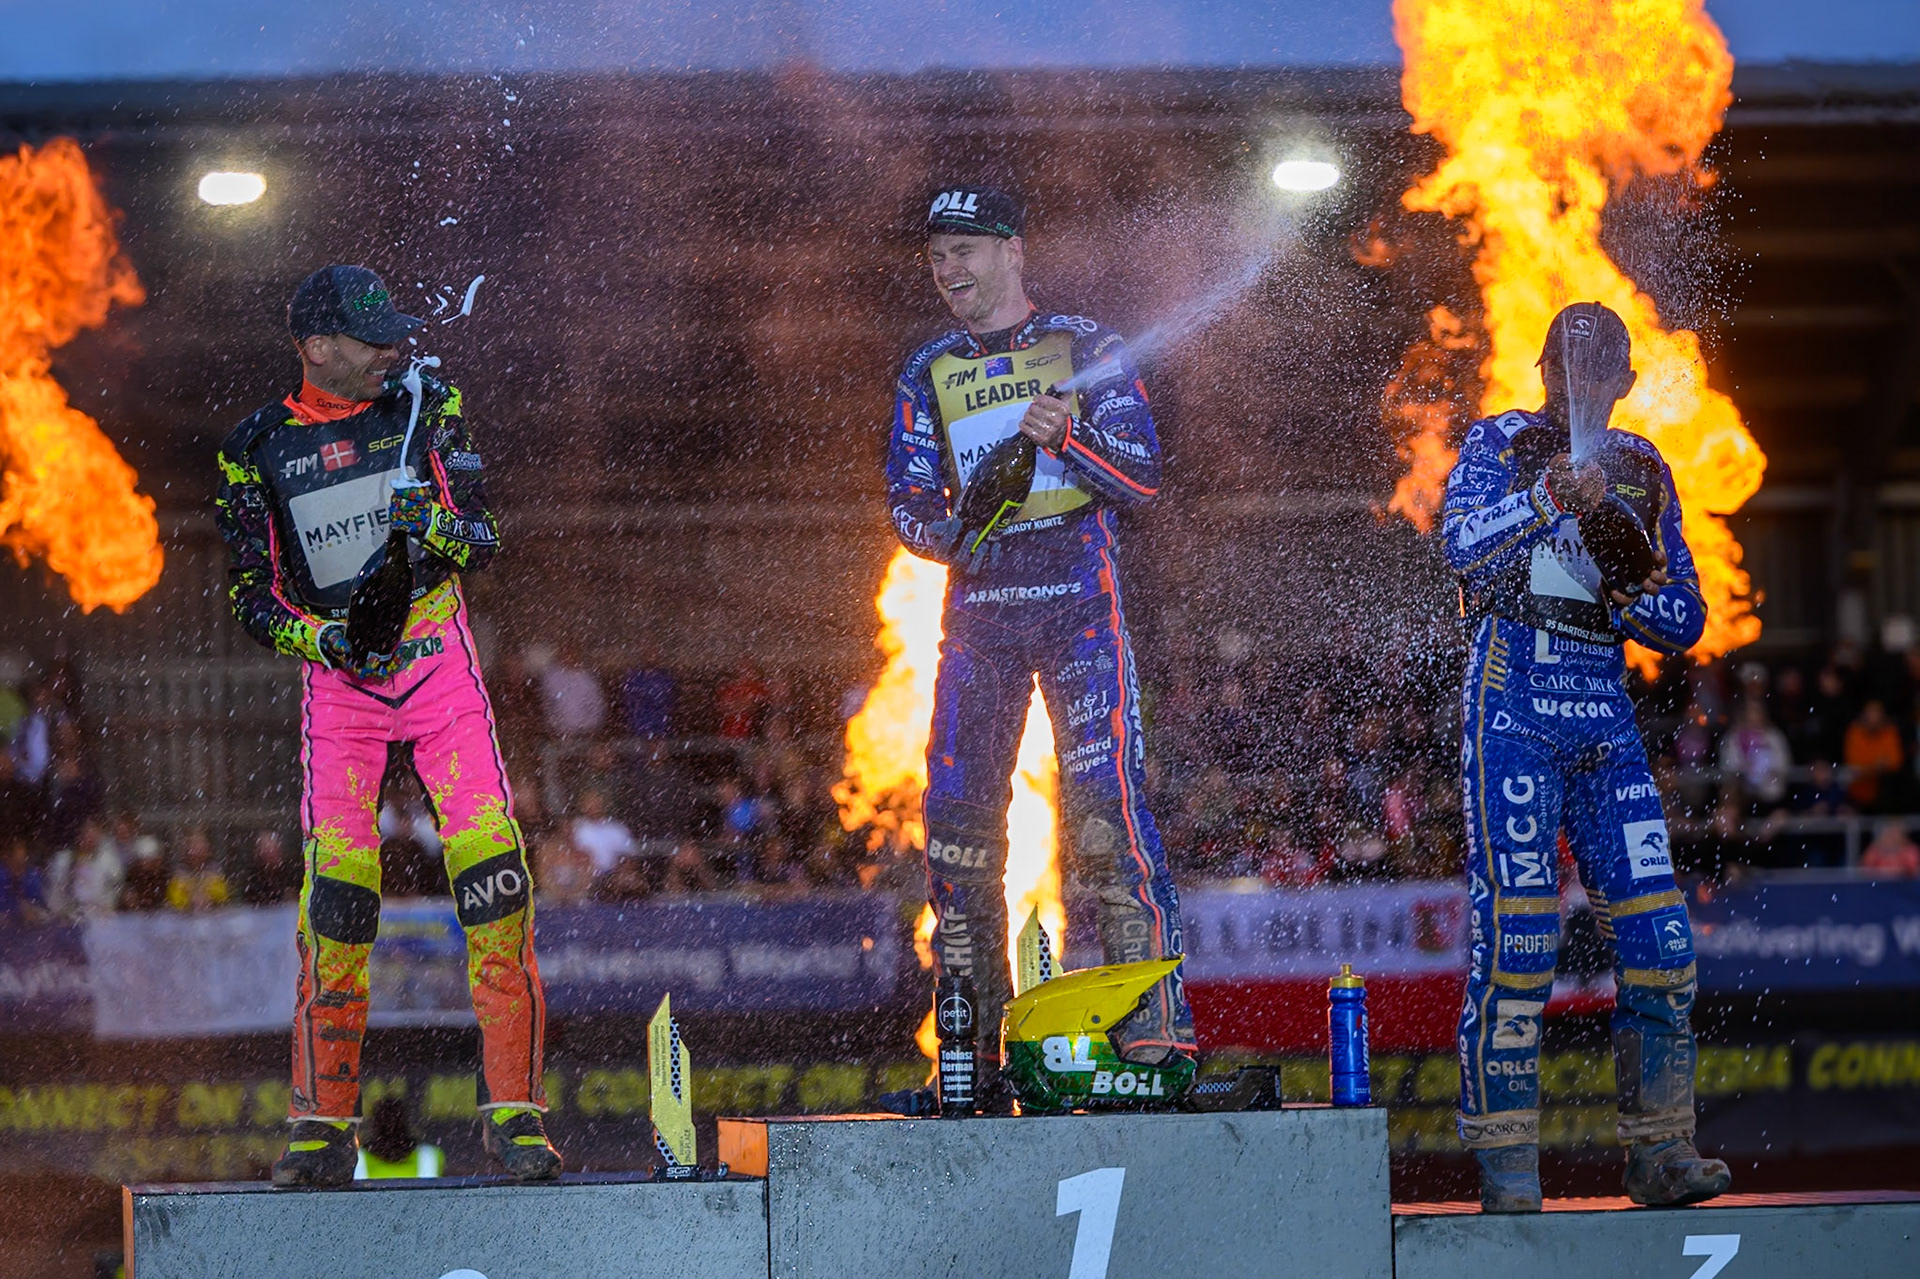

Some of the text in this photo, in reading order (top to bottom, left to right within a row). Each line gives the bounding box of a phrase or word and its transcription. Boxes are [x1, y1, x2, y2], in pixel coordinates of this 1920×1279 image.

[929, 191, 979, 221] OLL
[1024, 353, 1062, 371] SGP
[942, 367, 978, 391] FIM
[965, 378, 1042, 412] LEADER
[368, 434, 405, 453] SGP
[281, 453, 318, 479] FIM
[1616, 483, 1647, 498] SGP
[305, 508, 391, 547] MAYFIE
[1034, 515, 1064, 530] KURTZ
[964, 582, 1082, 604] ARMSTRONG'S
[1545, 618, 1557, 630] 95
[1557, 621, 1590, 640] BARTOSZ
[1529, 672, 1617, 694] GARCAREK
[1066, 689, 1108, 718] M & J
[1532, 697, 1615, 719] wecon
[1062, 736, 1112, 764] Richard
[1068, 753, 1108, 776] Hayes
[928, 838, 988, 868] BOLL
[463, 868, 523, 911] AVO
[942, 1009, 968, 1022] petit
[941, 1049, 973, 1061] Tobiasz
[941, 1062, 974, 1072] Herman
[1091, 1071, 1164, 1096] BOLL
[1508, 1079, 1531, 1092] OIL
[1056, 1167, 1126, 1279] 1
